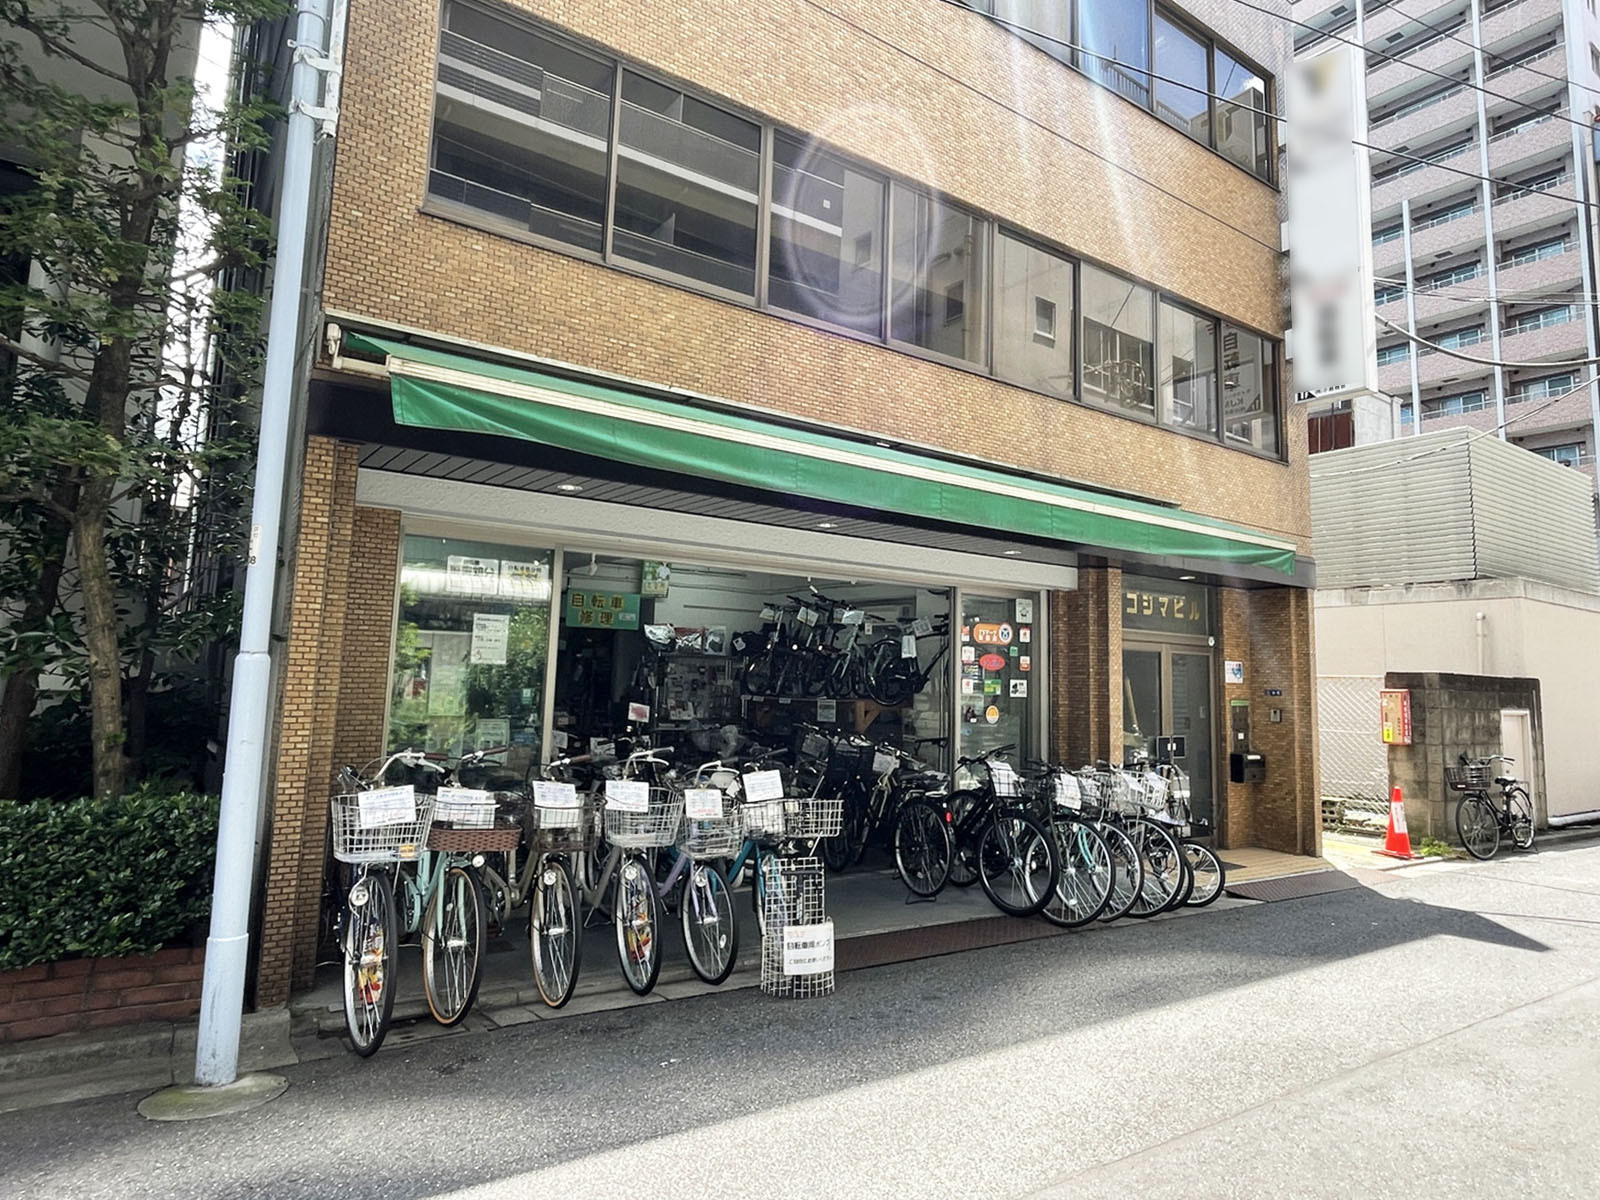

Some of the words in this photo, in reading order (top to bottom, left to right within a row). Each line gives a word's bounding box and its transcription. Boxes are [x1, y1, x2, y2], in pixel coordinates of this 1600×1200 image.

[571, 592, 624, 611] 自転車
[1126, 591, 1200, 620] コジマビル
[579, 608, 614, 625] 修理
